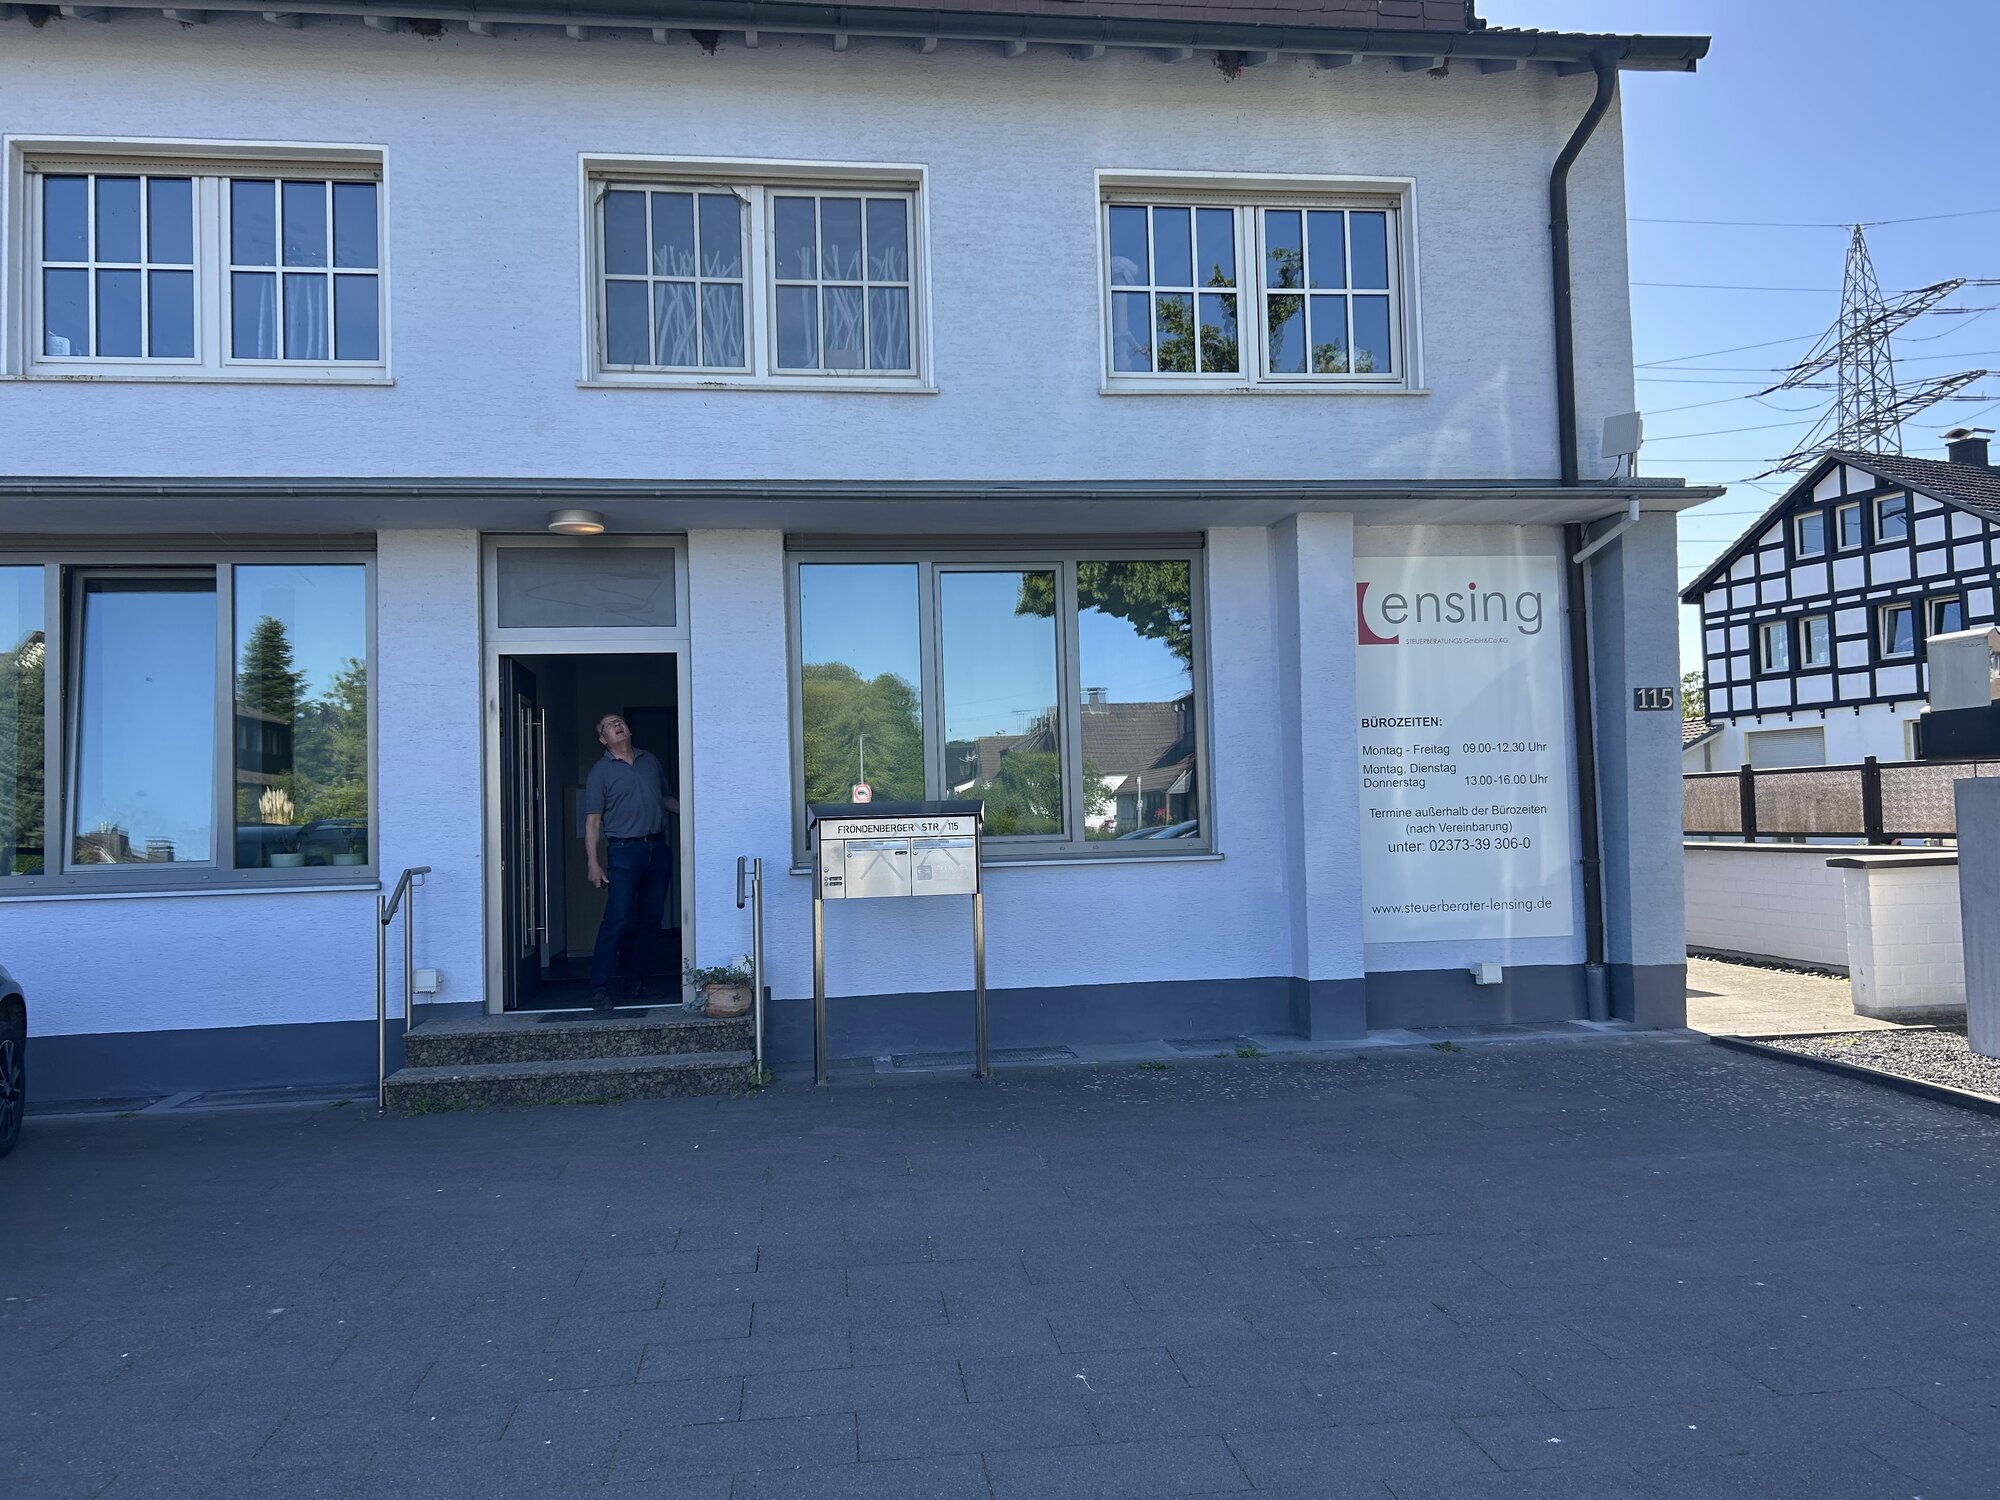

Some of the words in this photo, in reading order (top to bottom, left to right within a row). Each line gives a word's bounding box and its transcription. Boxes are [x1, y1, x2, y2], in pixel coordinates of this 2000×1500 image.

[1356, 582, 1543, 645] Lensing
[1405, 637, 1463, 645] STEUERBERATUNGS
[1637, 688, 1673, 709] 115
[1361, 716, 1443, 728] BÜROZEITEN:
[1362, 745, 1403, 757] Montag
[1413, 744, 1450, 755] Freitag
[1462, 742, 1525, 754] 09.00-12.30
[1528, 742, 1547, 752] Uhr
[1363, 765, 1407, 776] Montag,
[1410, 763, 1457, 775] Dienstag
[1363, 778, 1426, 788] Donnerstag
[1464, 775, 1526, 786] 13.00-16.00
[1529, 774, 1548, 784] Uhr
[1369, 808, 1412, 818] Termine
[1415, 806, 1468, 817] außerhalb
[1471, 805, 1488, 816] der
[1491, 804, 1547, 815] Bürozeiten
[837, 823, 914, 834] FRÖNDENBERGER
[921, 822, 939, 832] STR
[947, 822, 959, 831] 115
[1405, 823, 1436, 836] (nach
[1438, 821, 1513, 834] Vereinbarung)
[1388, 841, 1425, 853] unter:
[1429, 839, 1491, 852] 02373-39
[1494, 837, 1531, 849] 306-0
[1372, 896, 1552, 914] www.steuerberater-lensing.de
